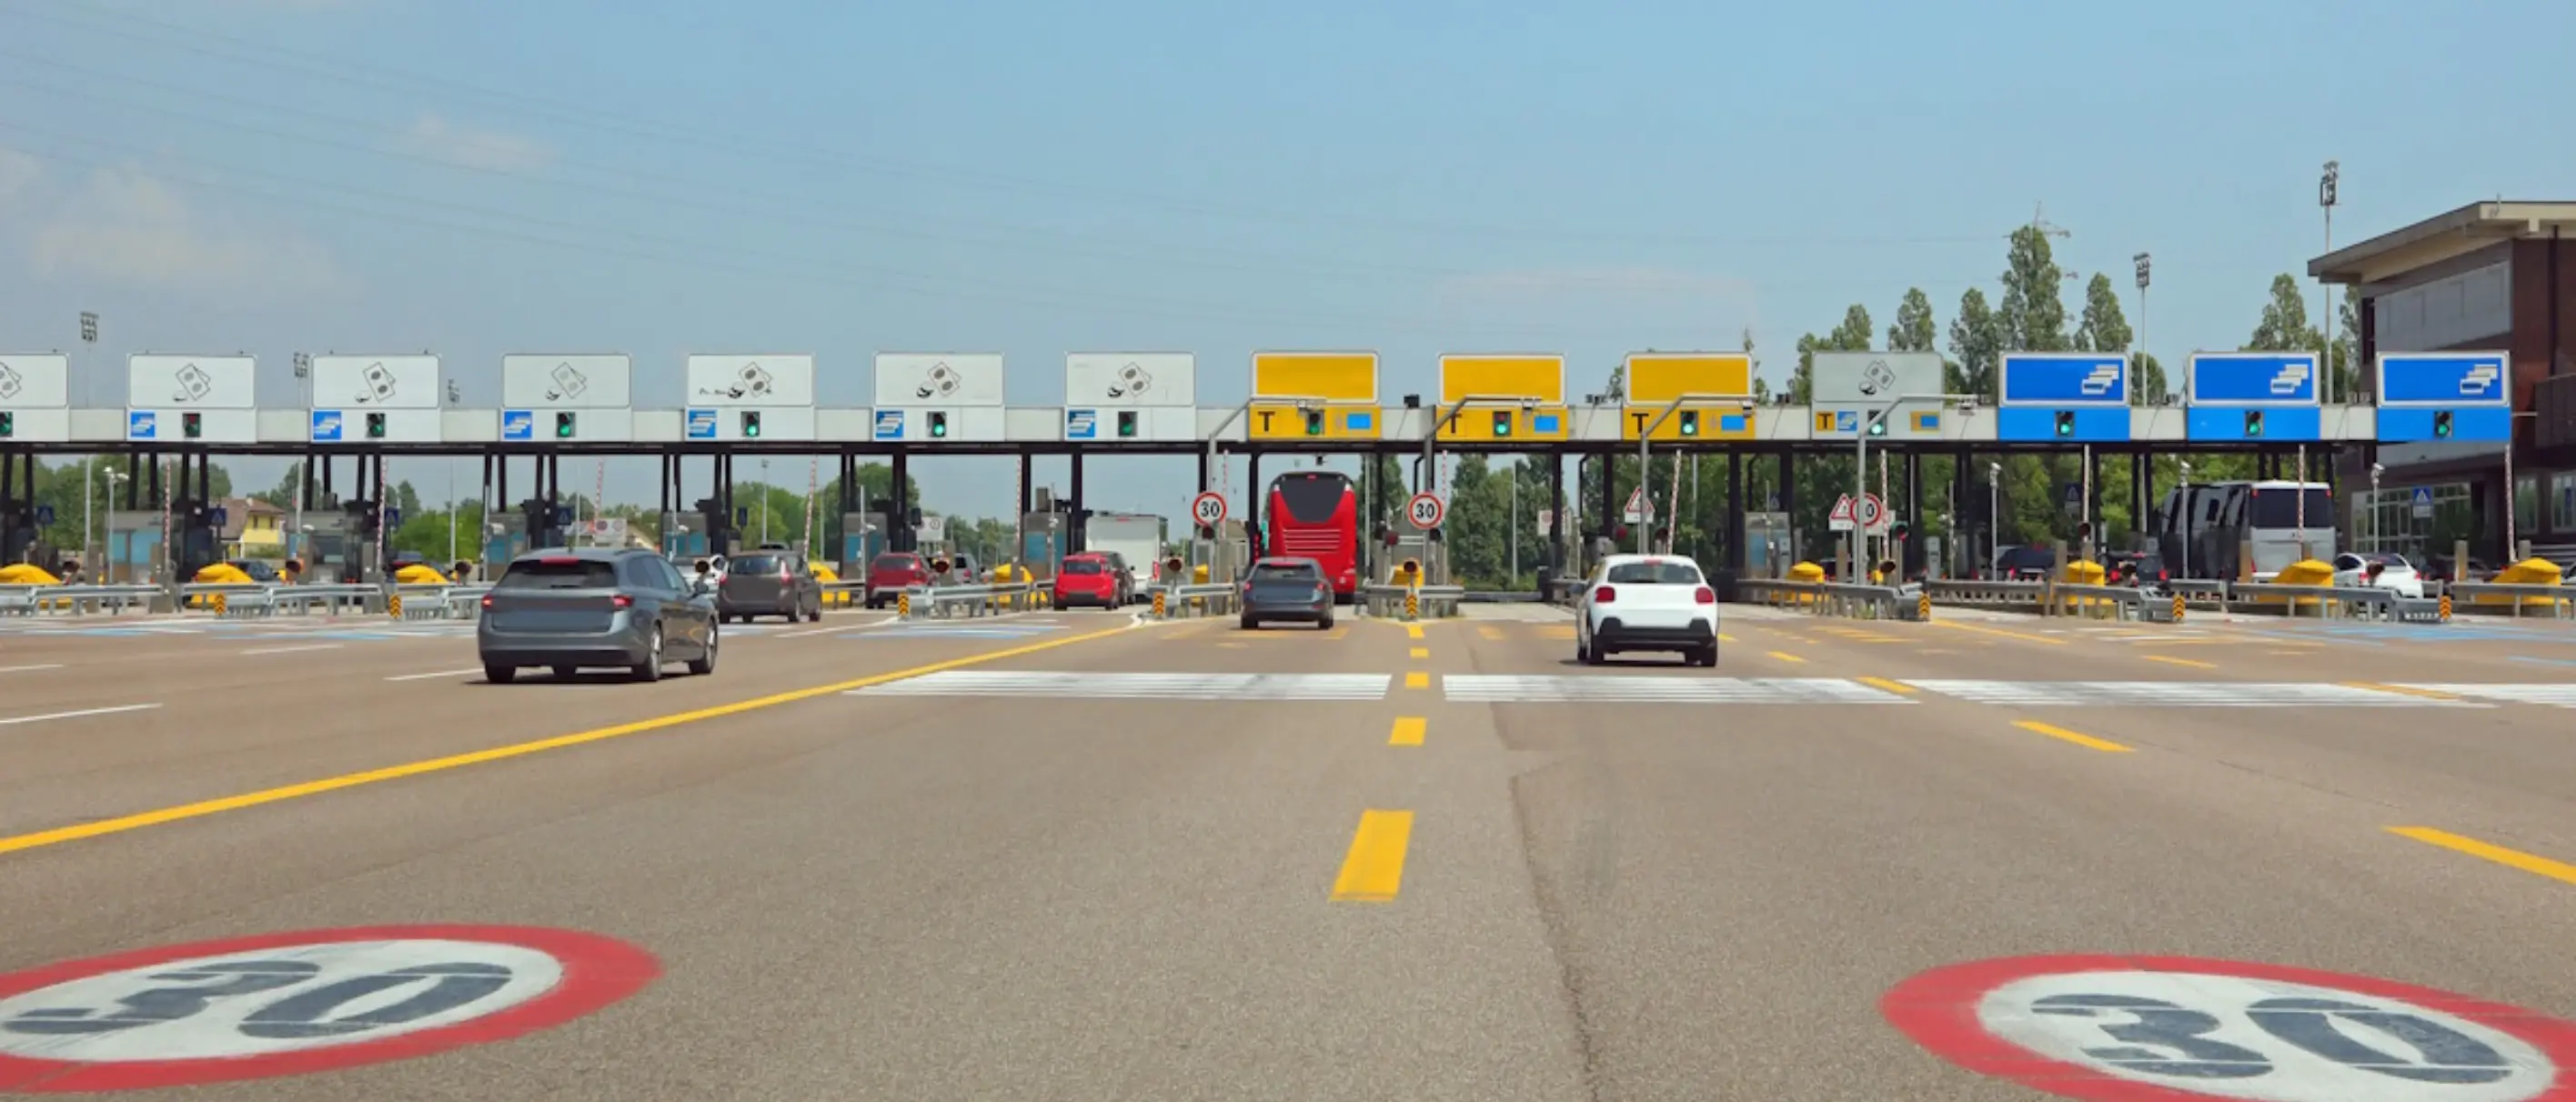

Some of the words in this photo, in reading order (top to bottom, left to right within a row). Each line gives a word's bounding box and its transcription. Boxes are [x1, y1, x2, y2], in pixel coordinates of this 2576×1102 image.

[1258, 411, 1275, 432] T
[1446, 412, 1463, 433] T
[1631, 413, 1649, 433] T
[1817, 413, 1833, 429] T
[1200, 501, 1220, 517] 30
[1416, 503, 1434, 519] 30
[2, 960, 513, 1039] 30
[2030, 994, 2513, 1084] 30
